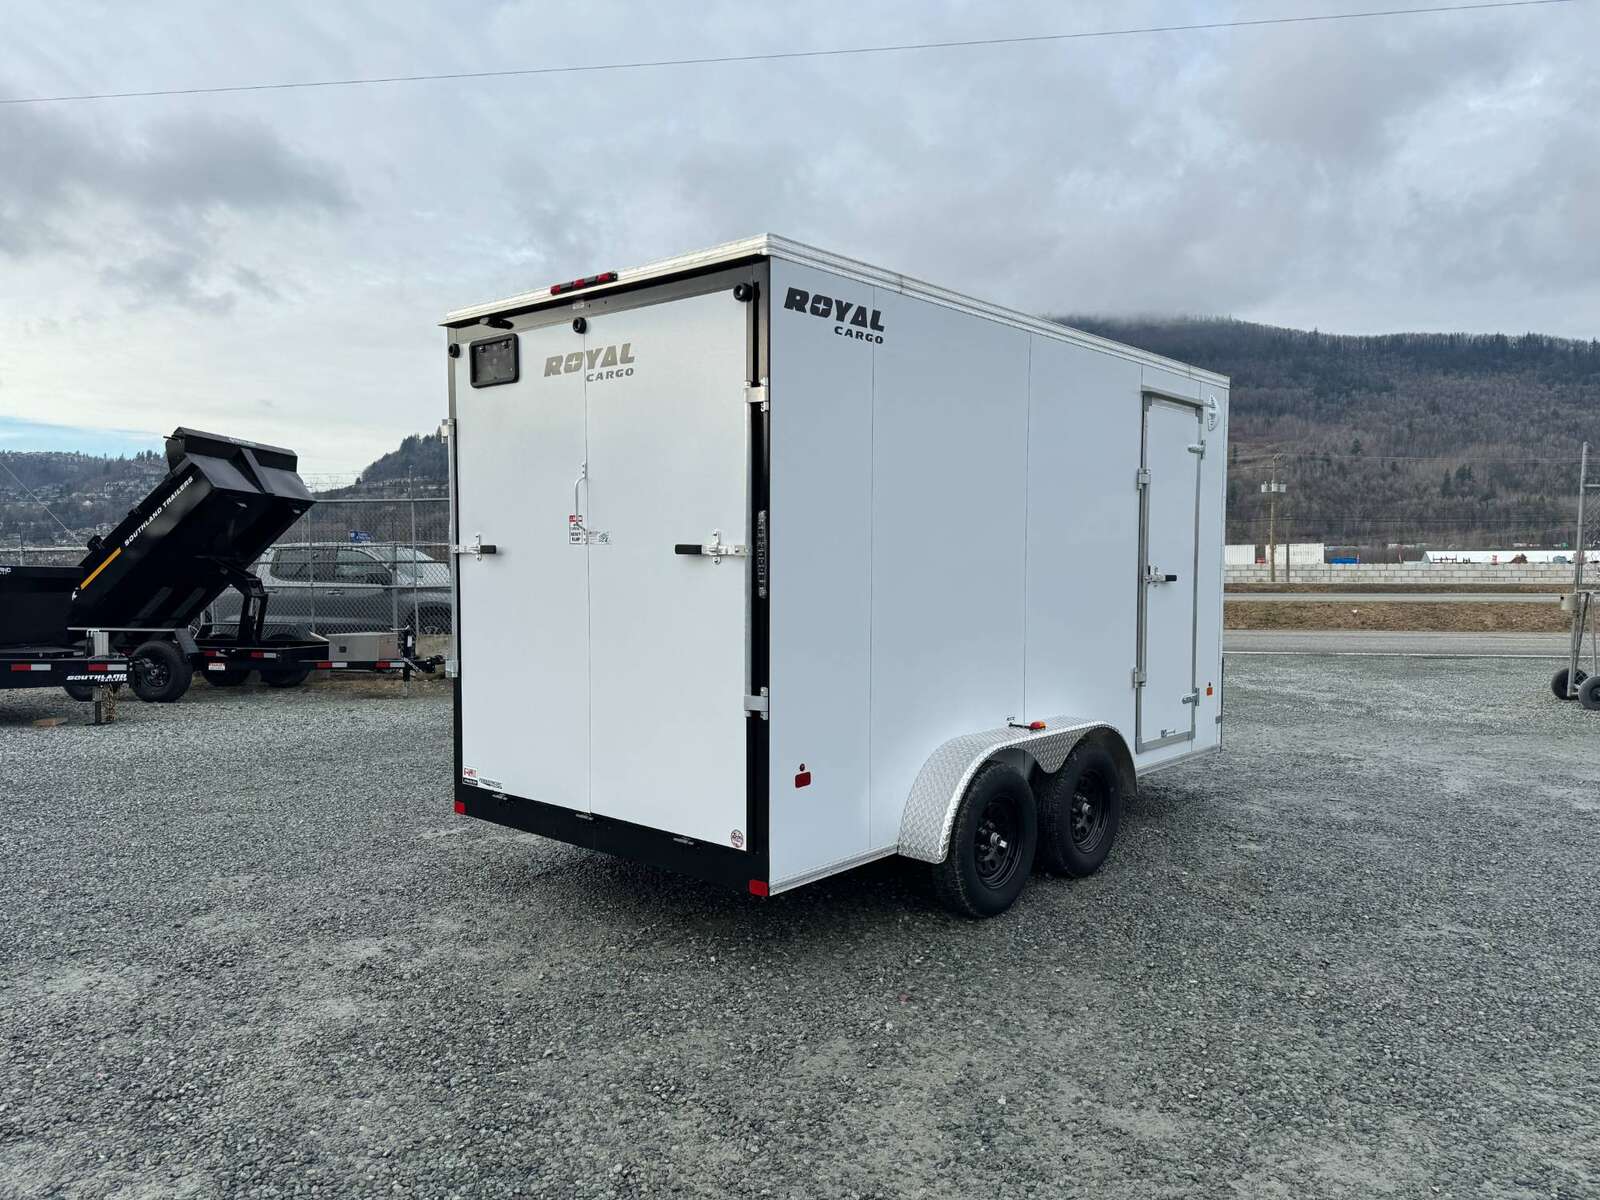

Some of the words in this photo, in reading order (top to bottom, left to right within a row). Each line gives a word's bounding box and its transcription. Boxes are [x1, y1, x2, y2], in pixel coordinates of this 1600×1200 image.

[783, 286, 885, 332] ROYAL
[834, 326, 884, 344] CARGO
[543, 342, 635, 377] ROYAL
[586, 367, 634, 382] CARGO
[124, 507, 163, 547] SOUTHLAND
[162, 475, 194, 509] TRAILERS
[66, 673, 128, 681] SOUTHLAND
